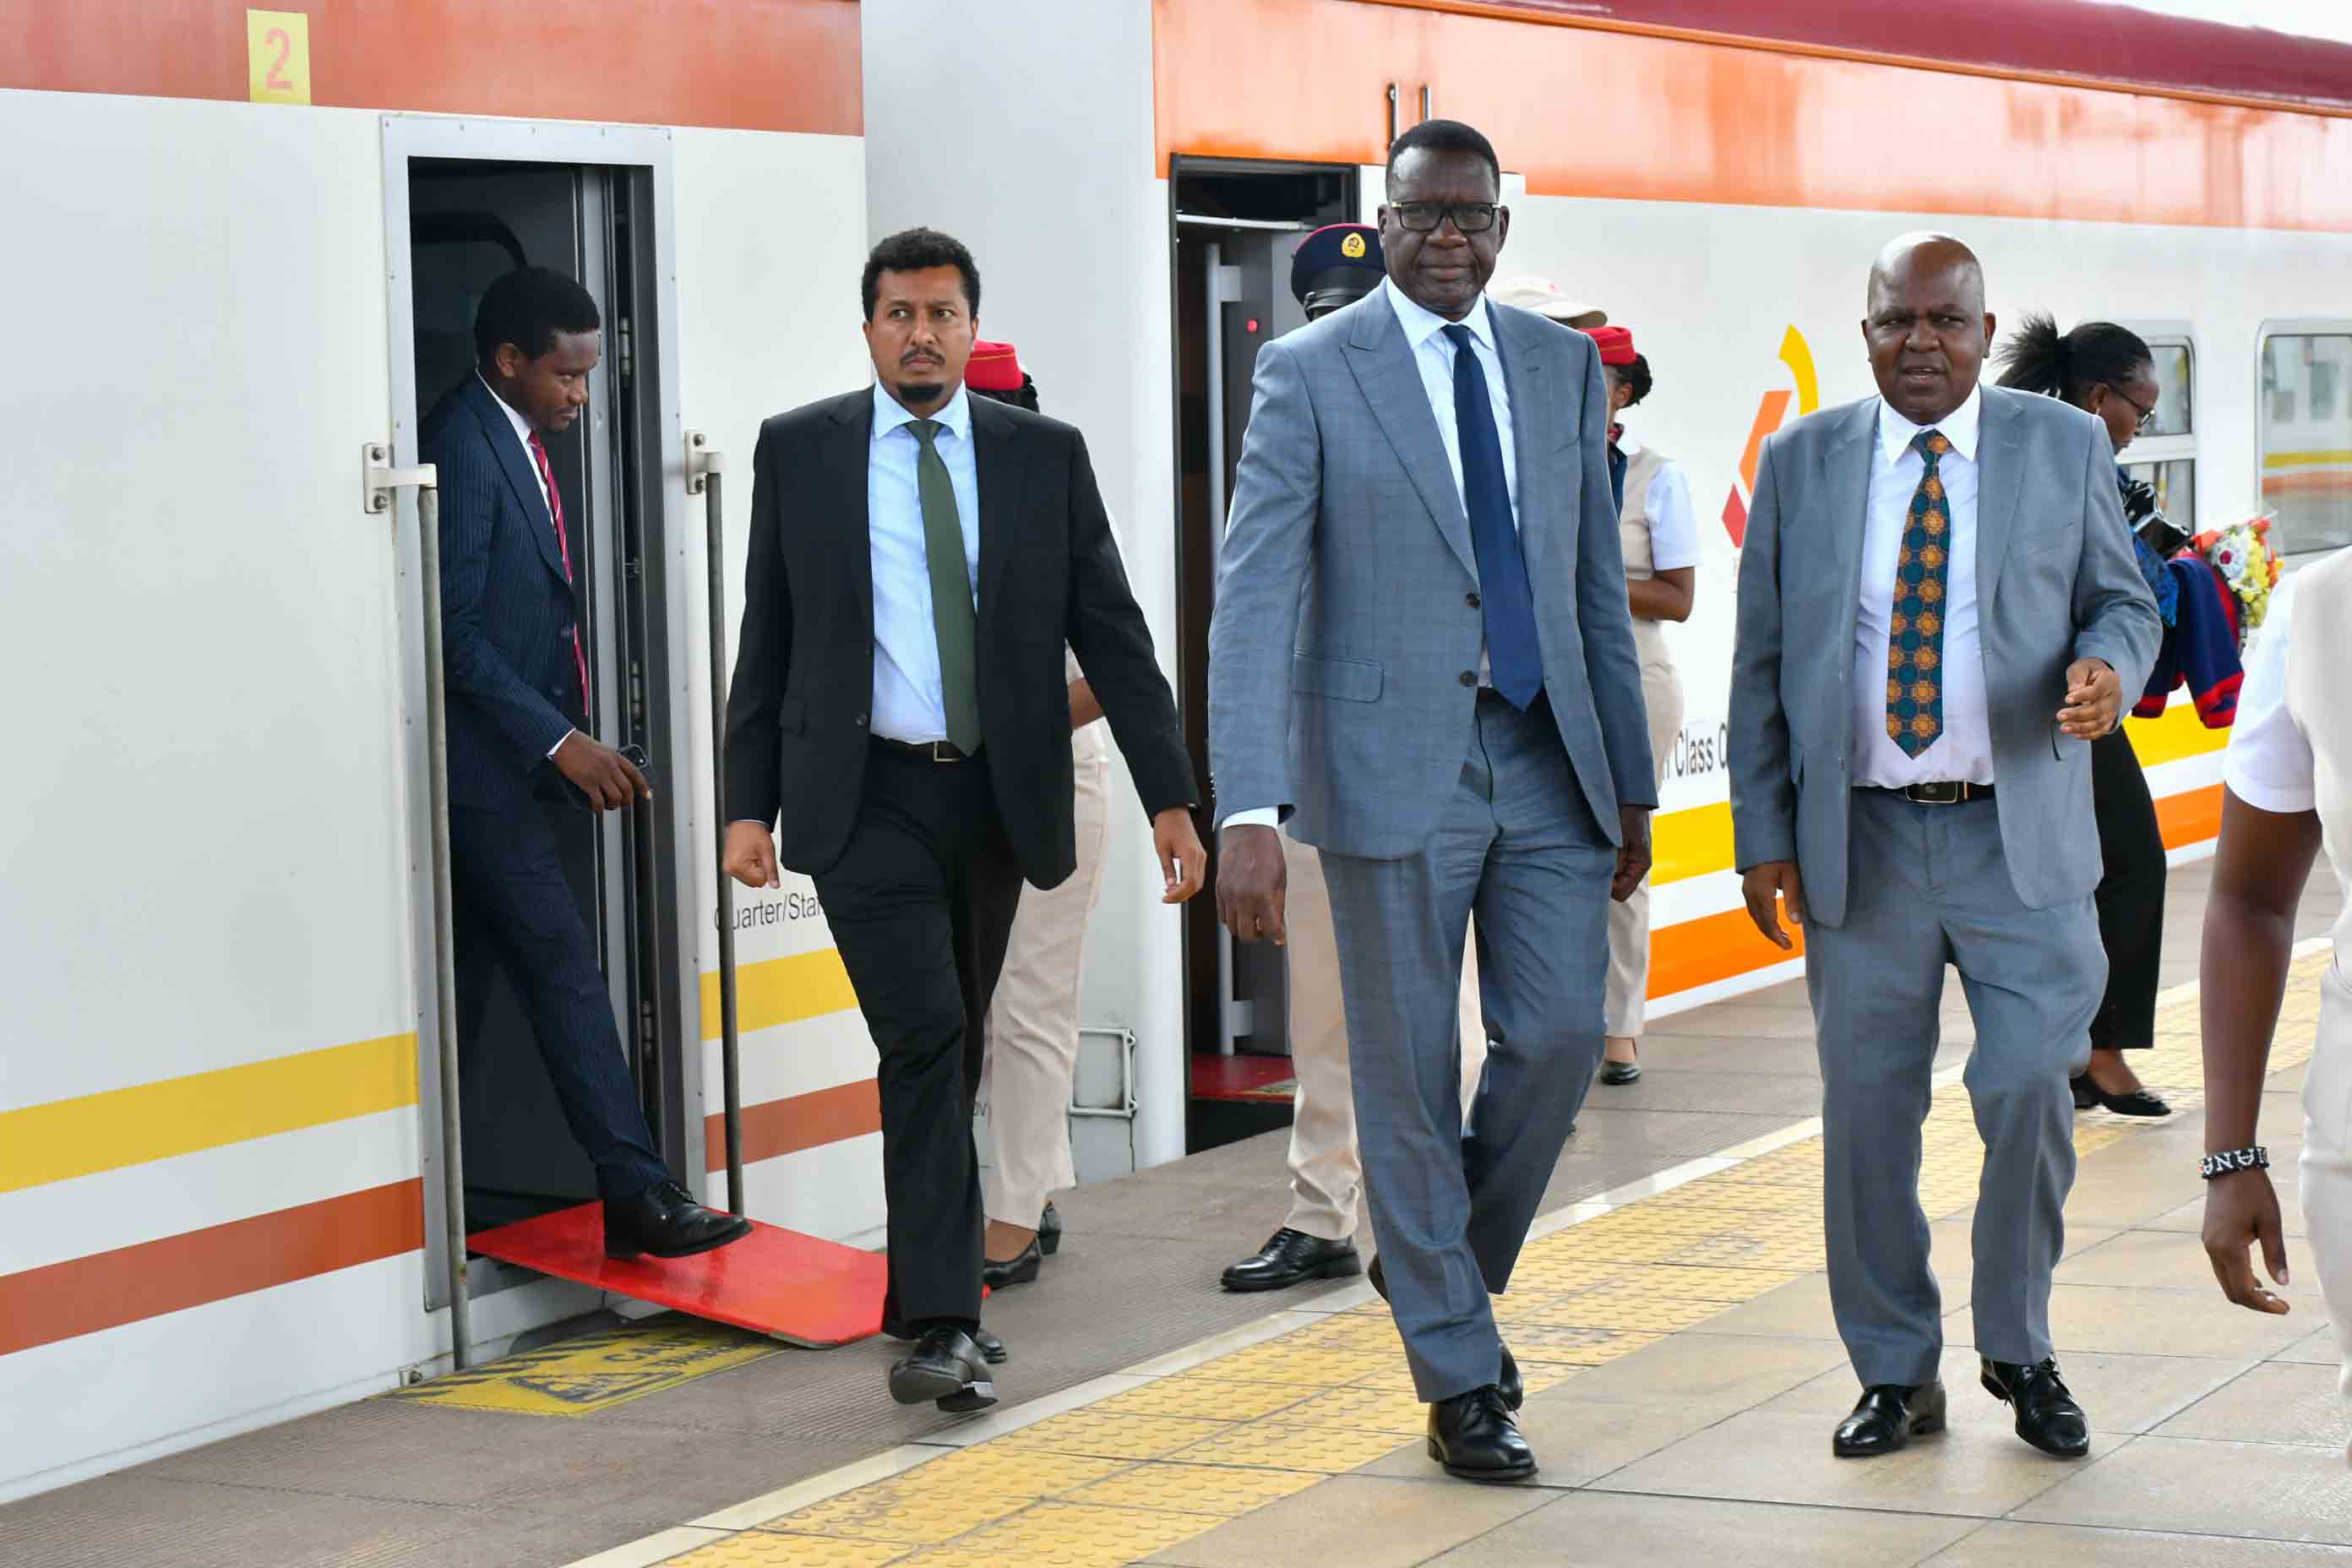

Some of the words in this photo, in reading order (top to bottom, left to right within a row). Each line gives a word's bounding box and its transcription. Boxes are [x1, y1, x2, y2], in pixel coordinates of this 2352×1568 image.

[264, 27, 292, 91] 2
[1675, 728, 1713, 777] Class
[715, 892, 820, 932] uarter/Sta
